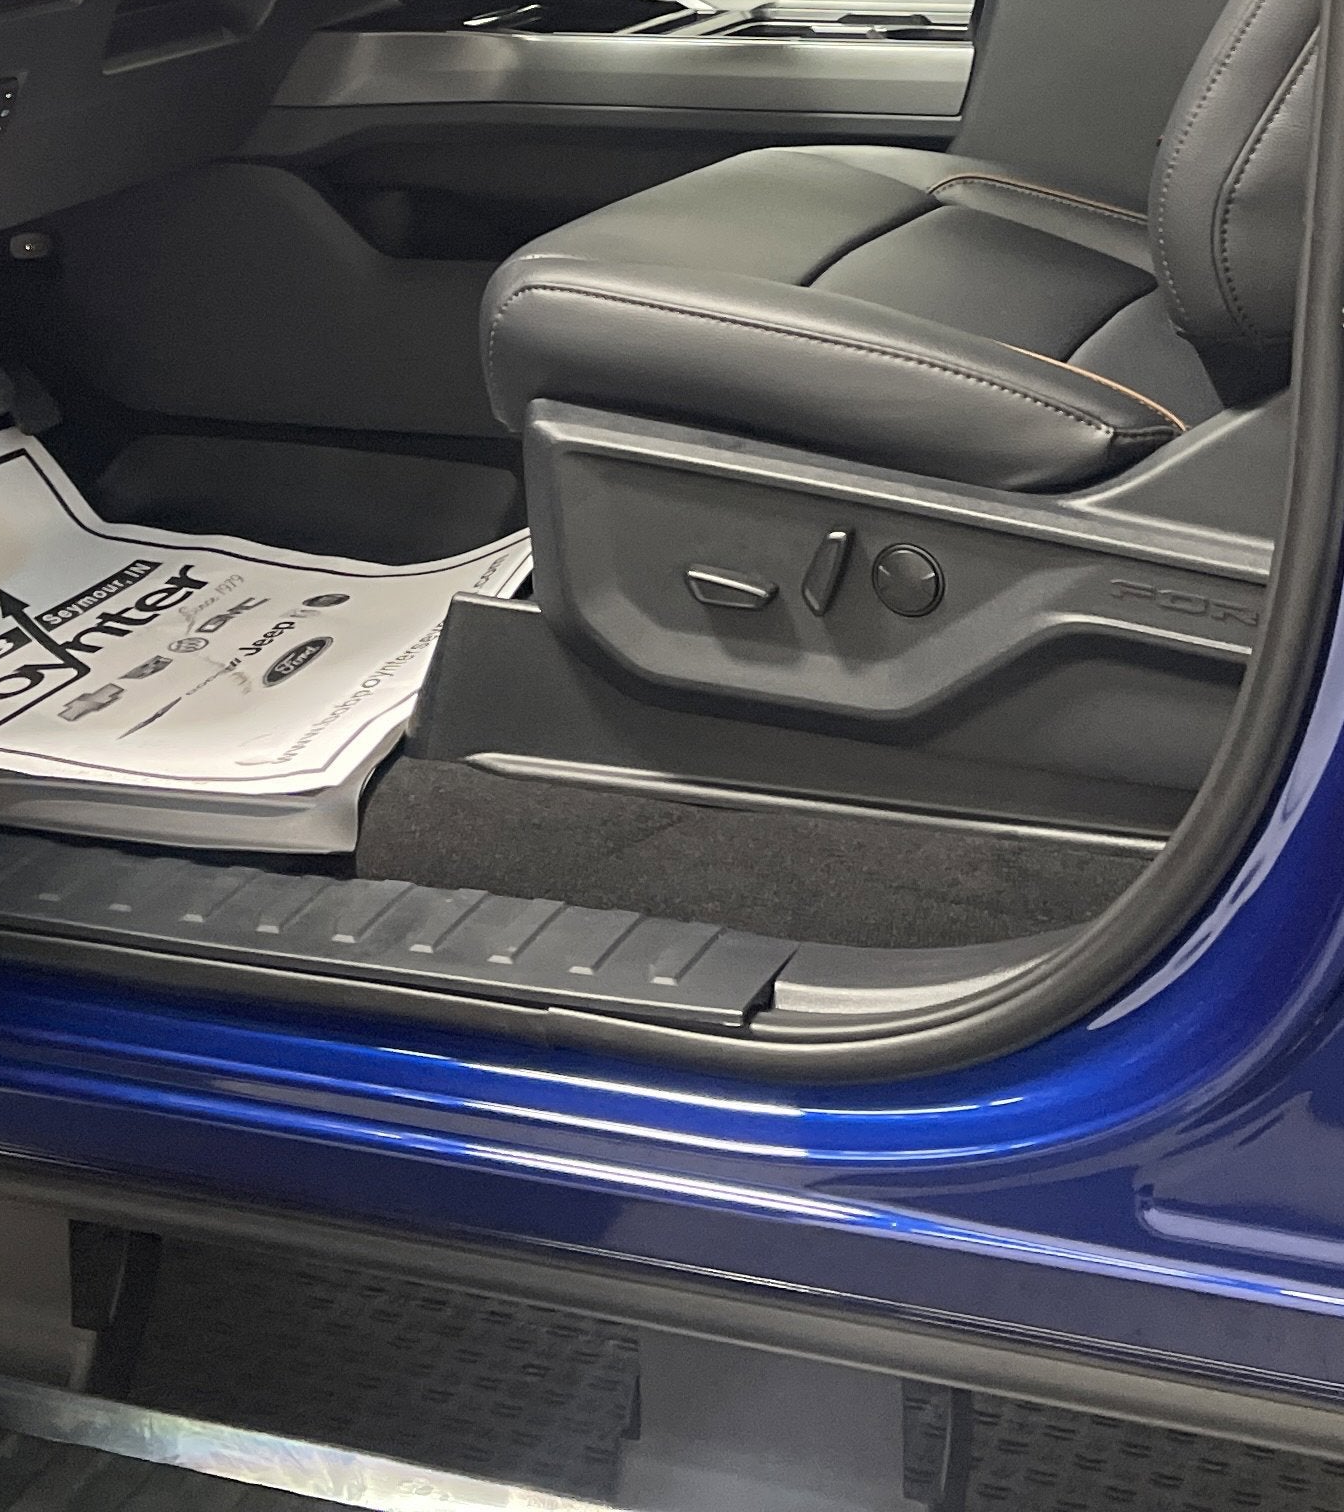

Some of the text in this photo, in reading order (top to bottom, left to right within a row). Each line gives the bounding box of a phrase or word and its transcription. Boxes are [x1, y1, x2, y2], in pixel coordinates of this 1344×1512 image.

[42, 562, 152, 626] Seymour, IN
[1110, 578, 1260, 627] FOR
[238, 620, 295, 657] Jeep
